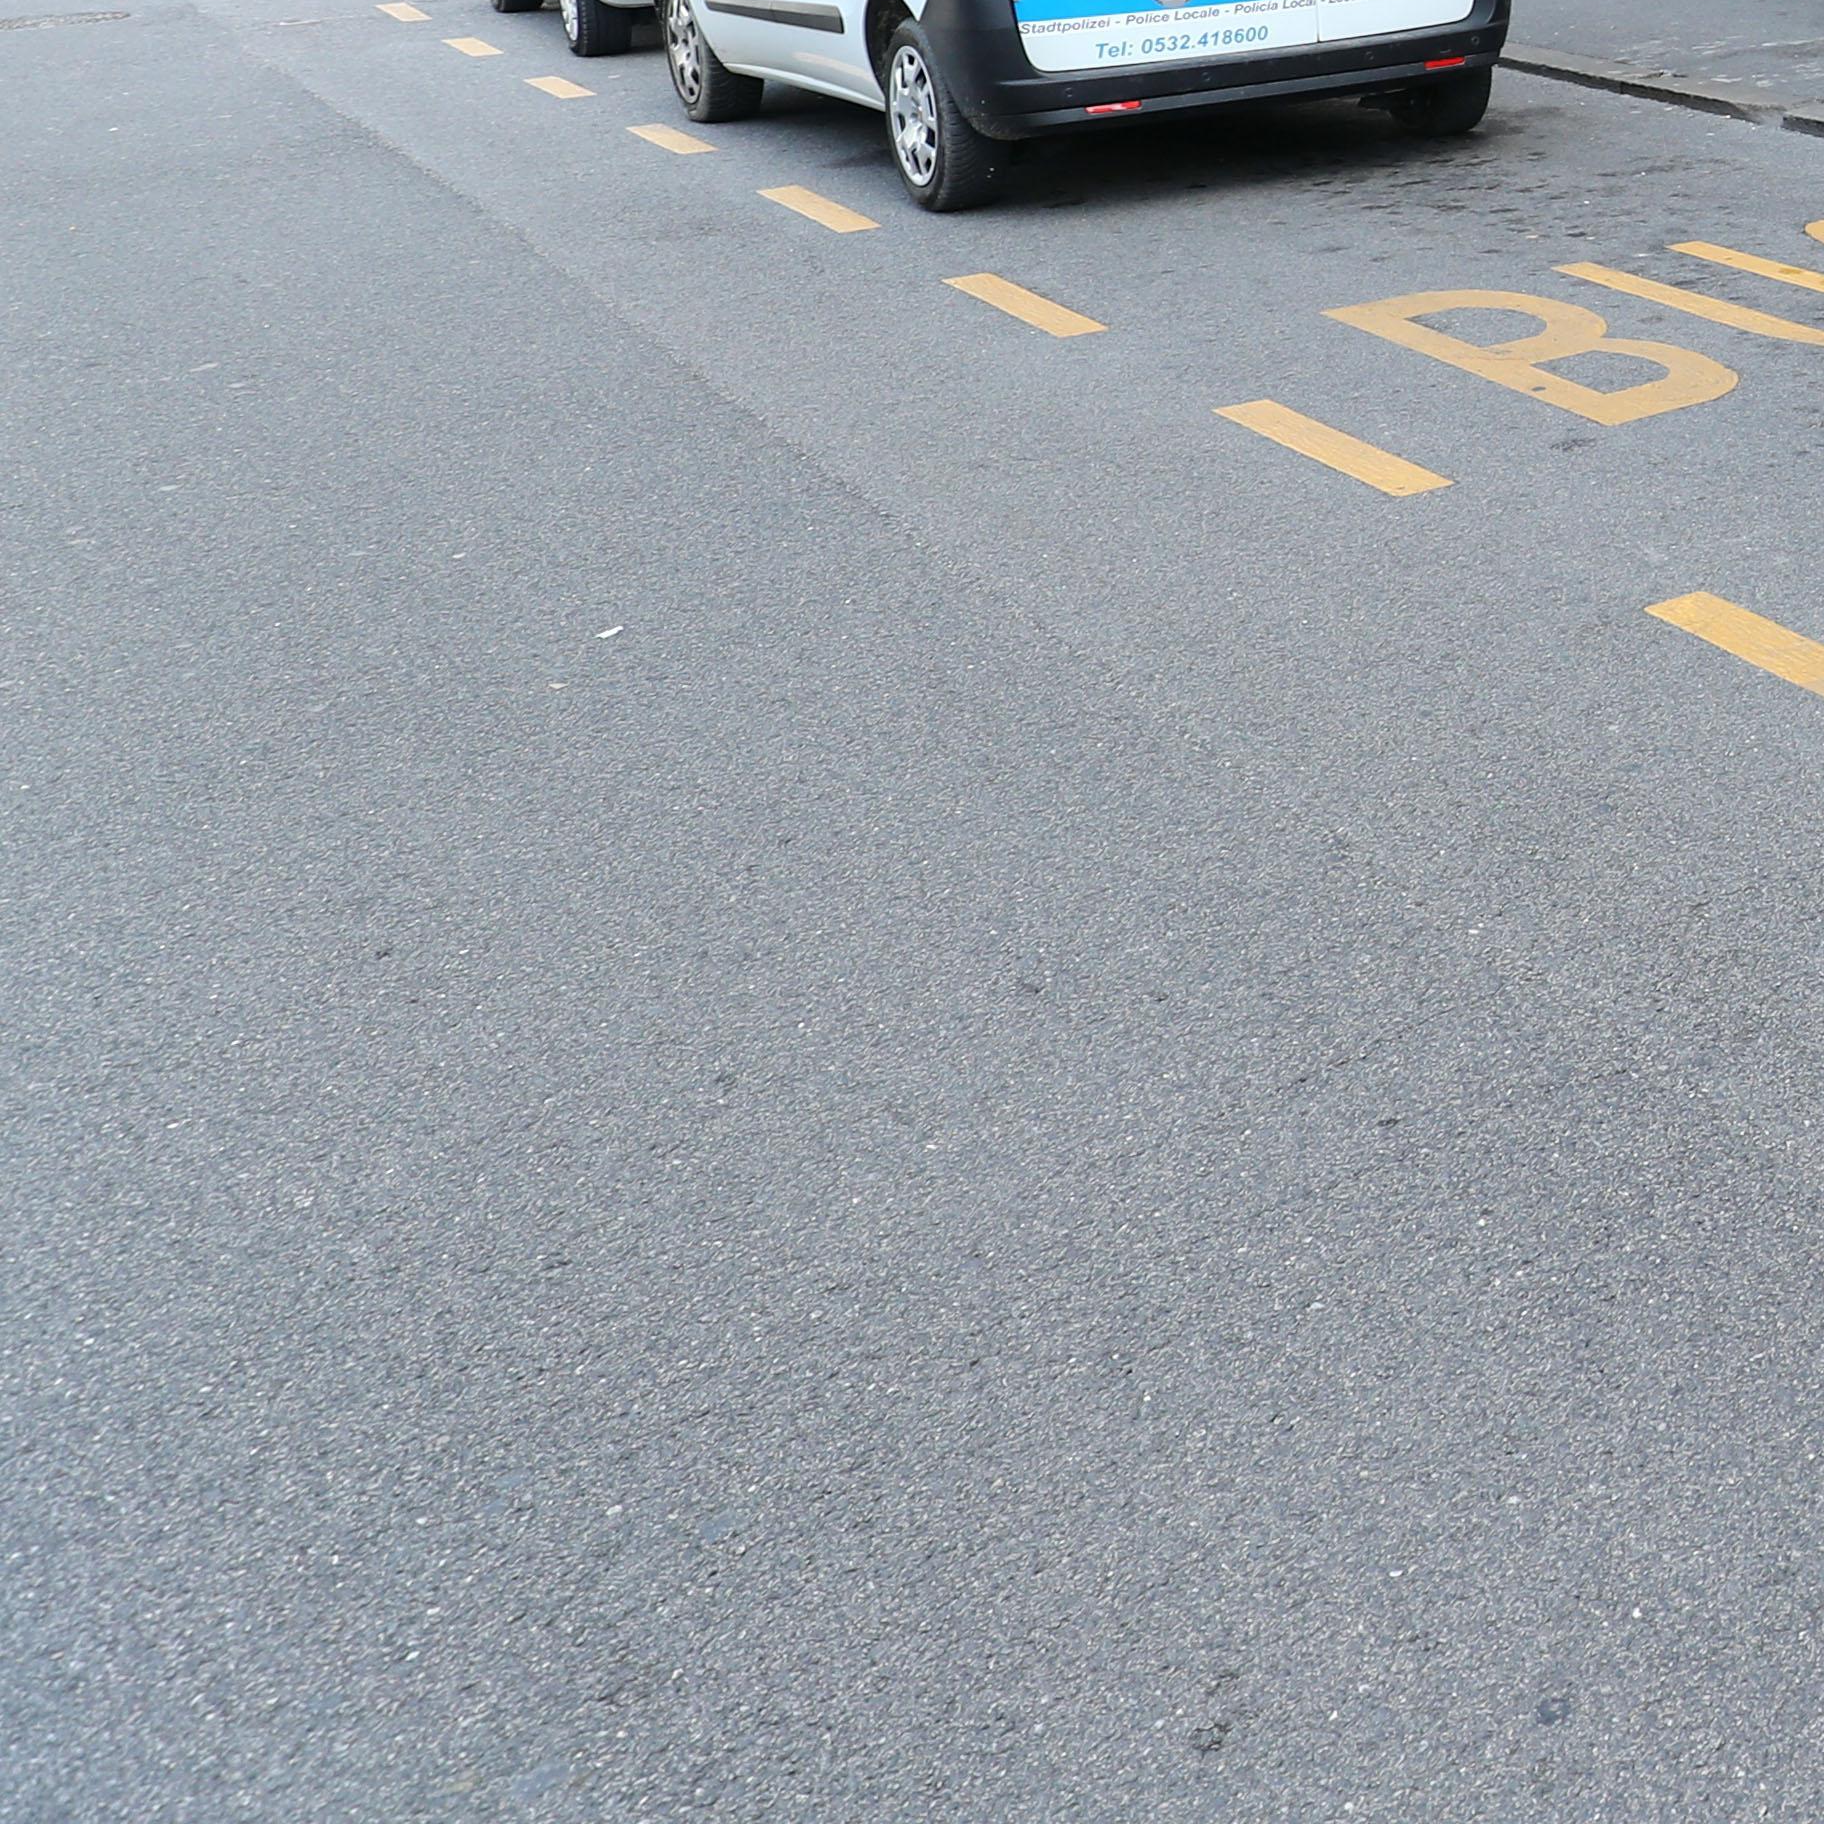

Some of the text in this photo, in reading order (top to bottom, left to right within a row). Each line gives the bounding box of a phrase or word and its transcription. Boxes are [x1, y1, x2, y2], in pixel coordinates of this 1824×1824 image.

[1019, 18, 1111, 37] Stadtpolizei
[1125, 11, 1171, 26] Police
[1174, 6, 1221, 23] Locale
[1095, 25, 1269, 59] Tel: 0532.418600
